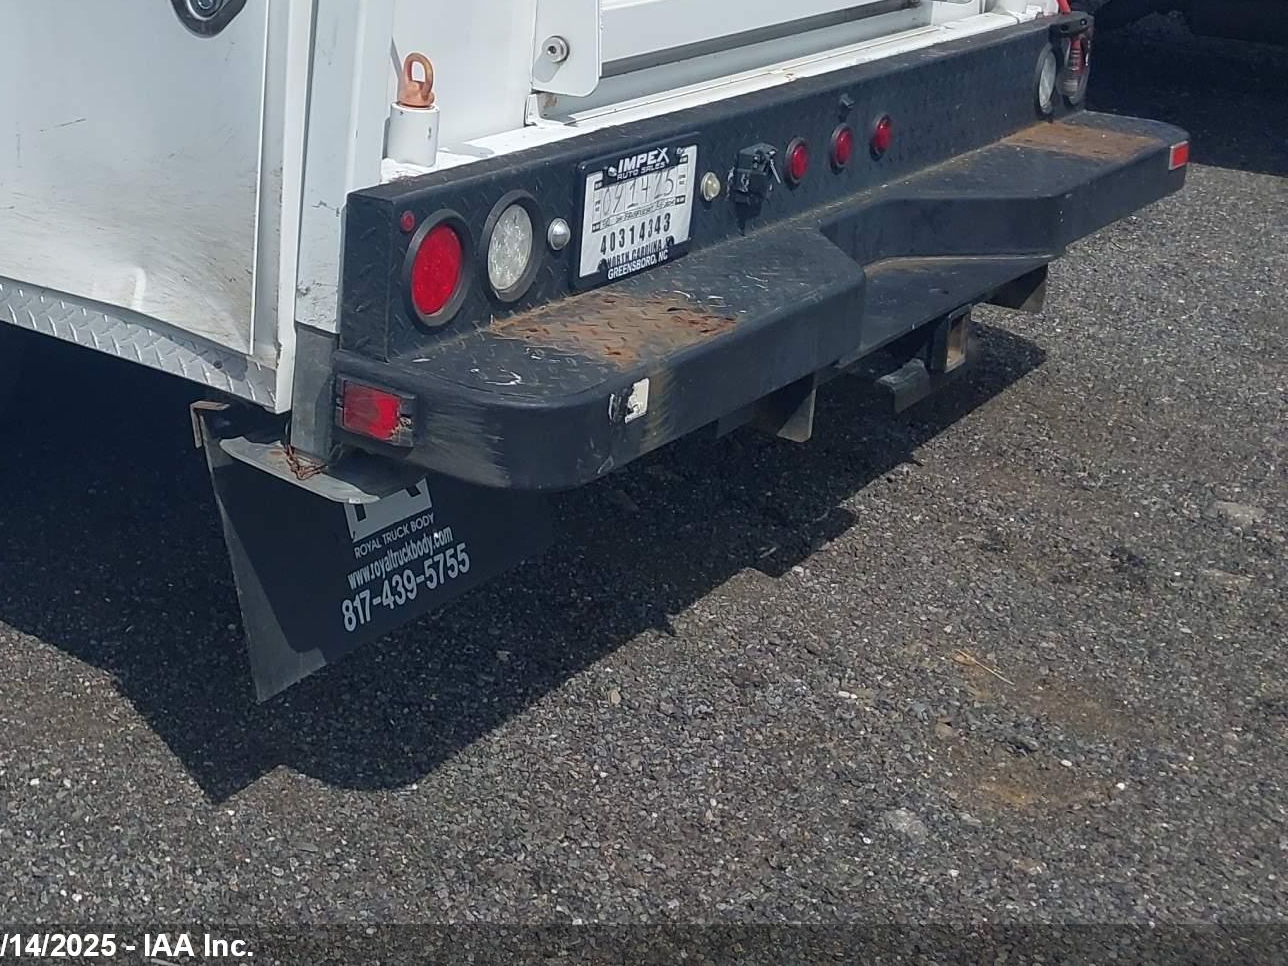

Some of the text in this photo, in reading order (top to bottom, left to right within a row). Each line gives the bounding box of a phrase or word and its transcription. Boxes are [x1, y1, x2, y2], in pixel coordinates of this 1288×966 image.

[616, 162, 666, 181] AUTO SALES
[618, 147, 670, 173] IMPEX
[600, 212, 672, 256] 40314343
[608, 249, 669, 280] GREENSBORO, NC
[347, 525, 454, 590] www.royaltruckbody.com
[354, 512, 435, 559] ROYAL TRUCK BODY
[341, 542, 470, 632] 817-439-5755
